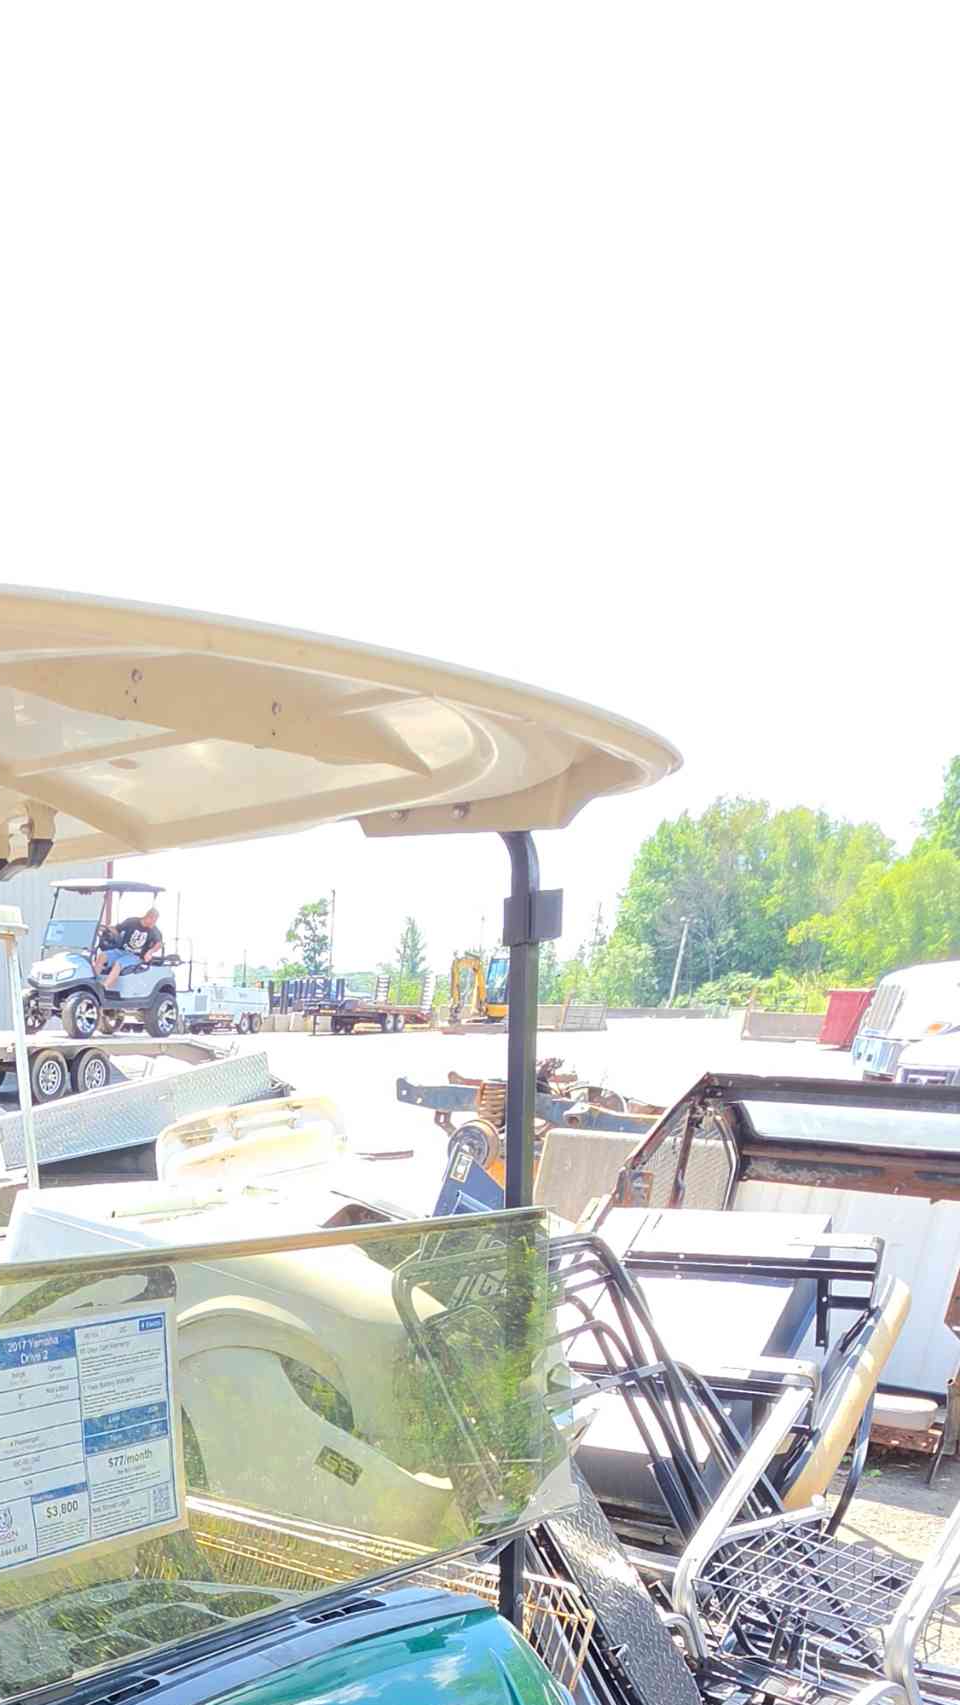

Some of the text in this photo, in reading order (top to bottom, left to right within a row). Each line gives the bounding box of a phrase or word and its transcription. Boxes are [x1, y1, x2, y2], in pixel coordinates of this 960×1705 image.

[7, 1336, 59, 1353] 2017 Yamaha
[20, 1351, 42, 1364] Drive
[108, 1447, 153, 1468] $77/month
